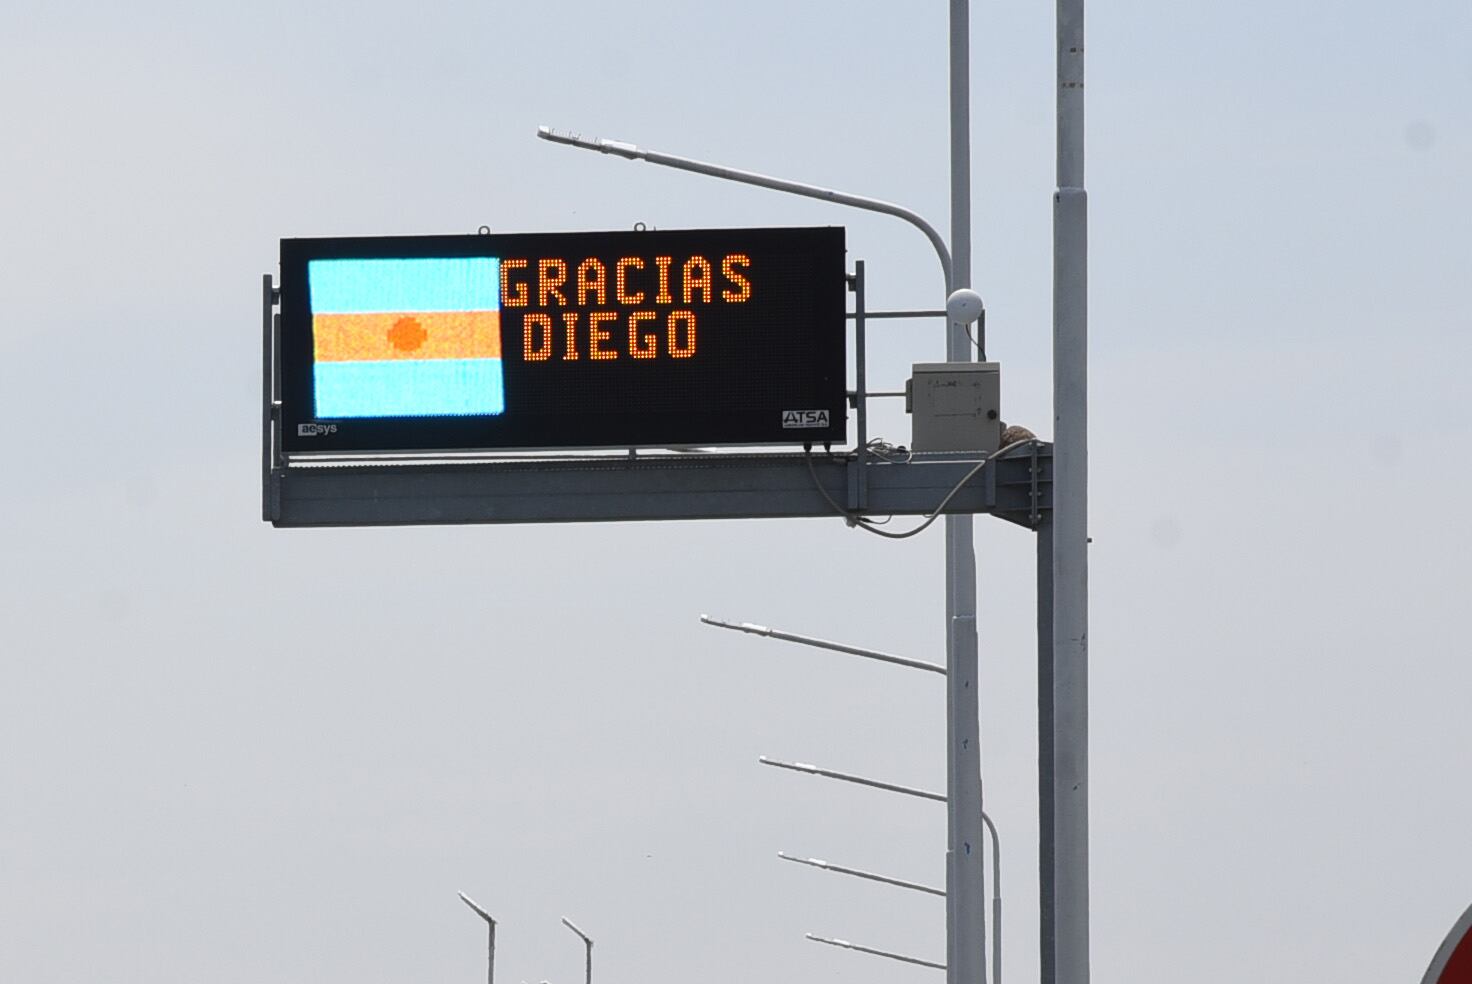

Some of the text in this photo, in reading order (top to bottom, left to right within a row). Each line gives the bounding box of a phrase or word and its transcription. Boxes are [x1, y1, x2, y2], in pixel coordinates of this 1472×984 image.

[500, 254, 750, 307] GRACIAS
[523, 310, 696, 361] DIEGO
[301, 424, 337, 436] aesys
[783, 411, 828, 424] ATSA
